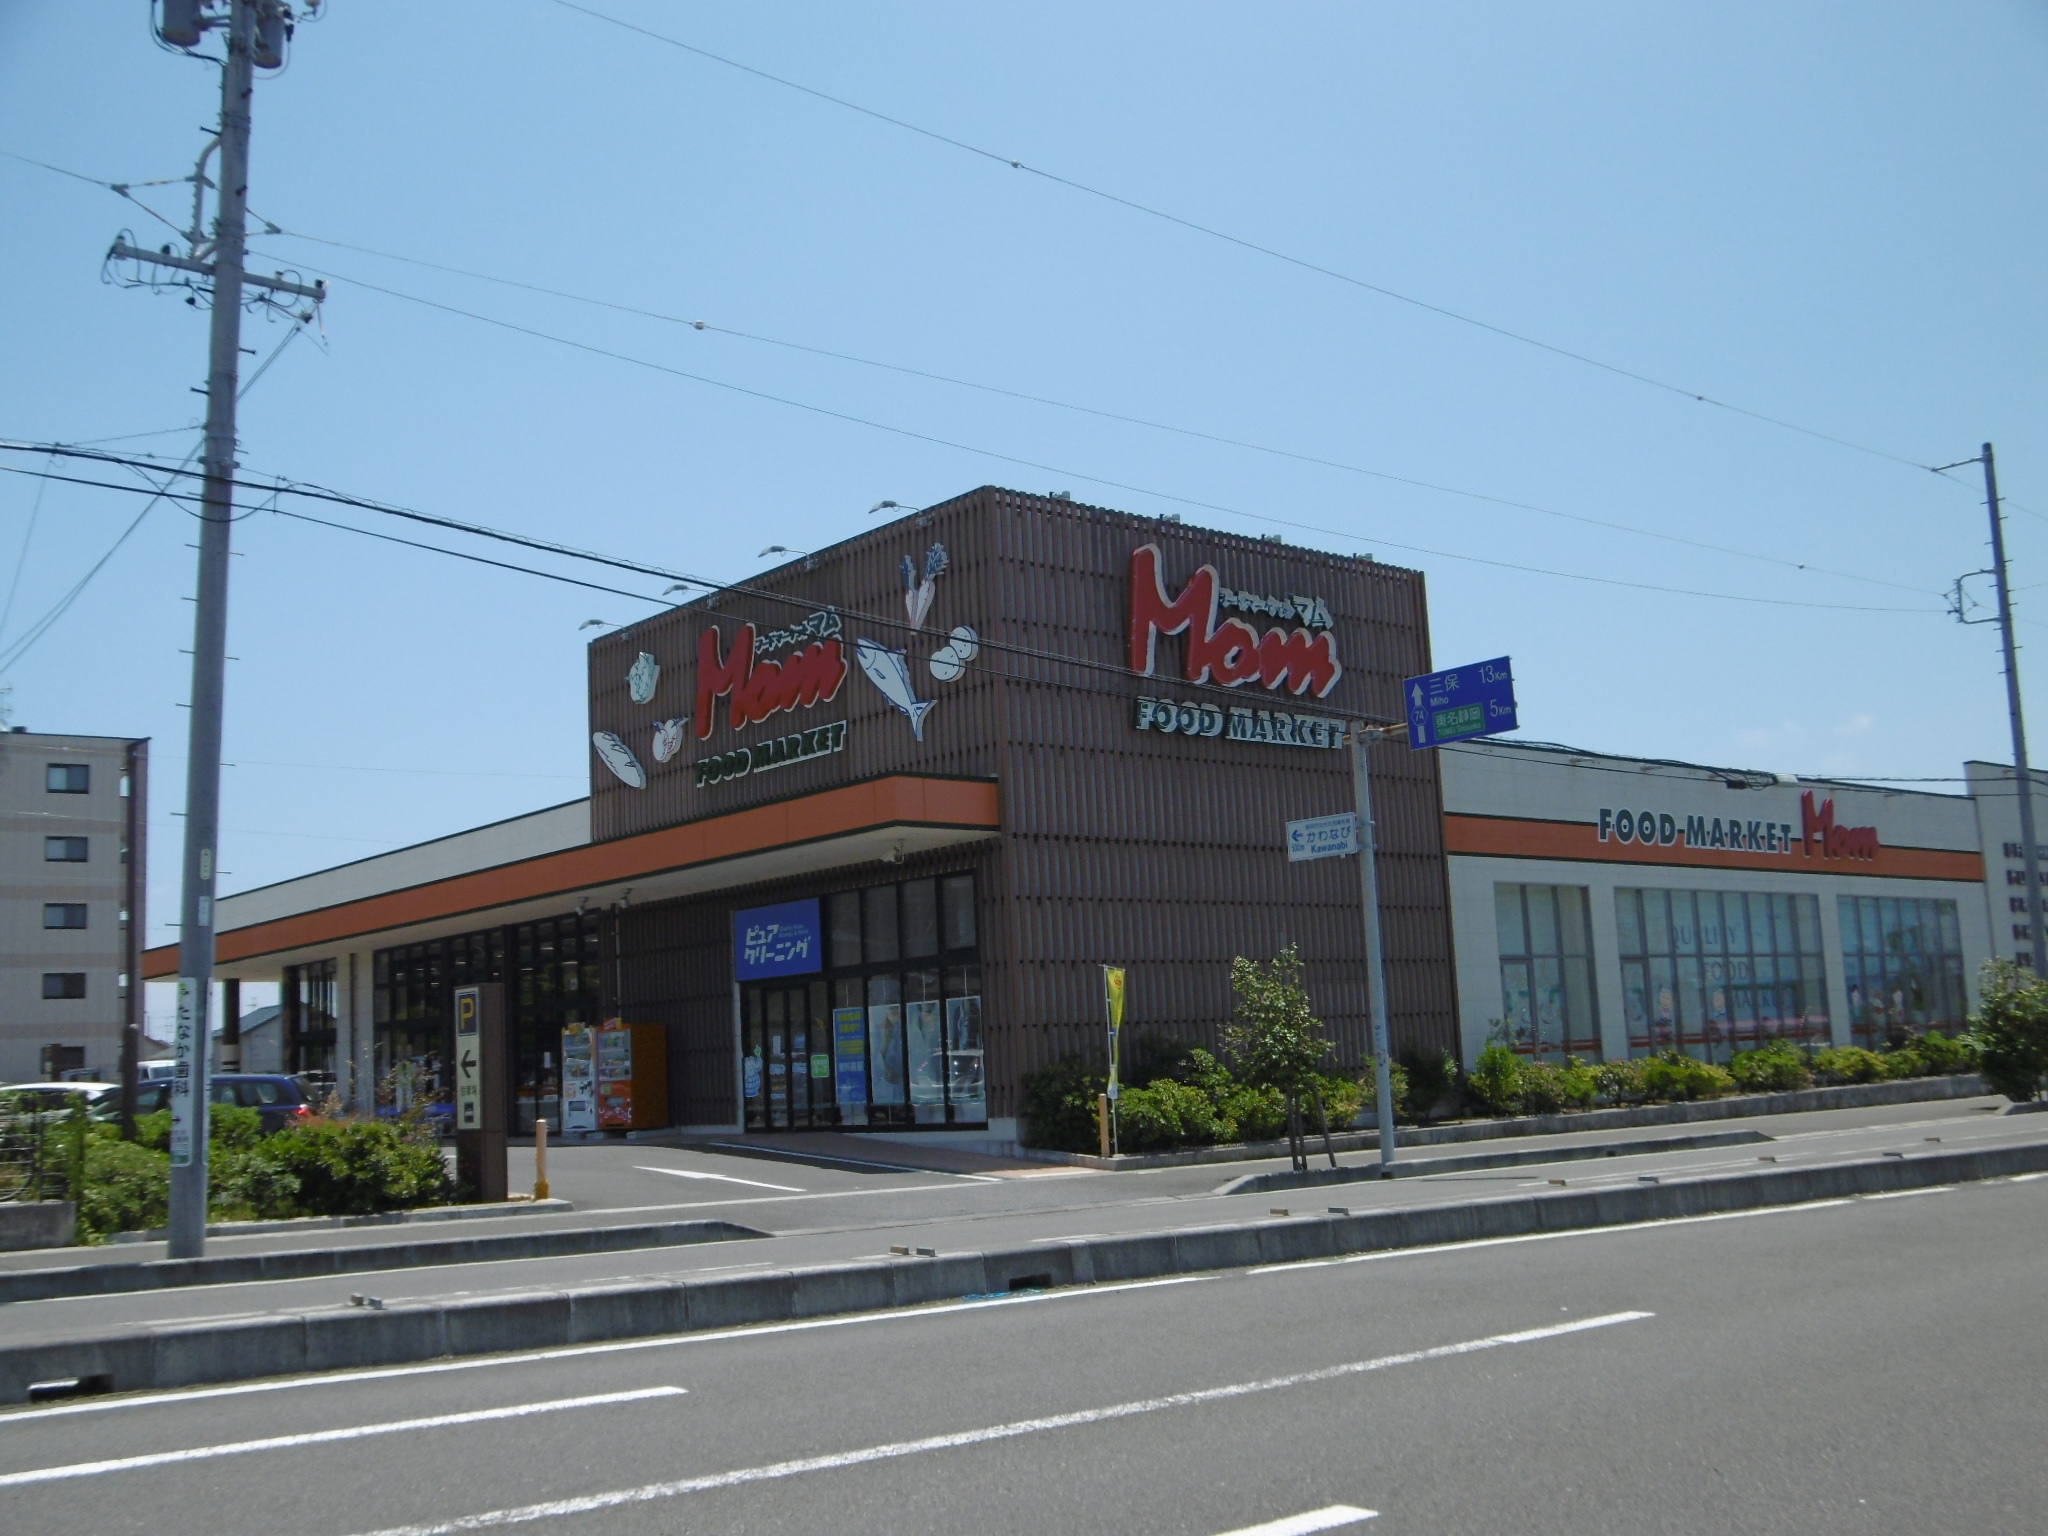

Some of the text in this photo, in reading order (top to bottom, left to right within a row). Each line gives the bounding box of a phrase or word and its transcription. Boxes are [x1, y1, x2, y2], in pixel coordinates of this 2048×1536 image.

[1131, 543, 1343, 699] Mom
[696, 623, 848, 741] Mom
[1429, 673, 1460, 695] 三保
[1414, 709, 1425, 722] 74
[1430, 696, 1449, 707] Miho
[1435, 706, 1481, 728] 東名静岡
[1136, 695, 1346, 749] FOOD MARKET
[696, 720, 848, 788] FOOD MARKET
[1306, 825, 1351, 844] かわなび
[1598, 807, 1793, 855] FOOD MARKET
[1800, 789, 1880, 862] Mom
[1291, 840, 1348, 854] 500m Kawanabi
[744, 935, 812, 965] クリーニング
[746, 924, 780, 946] ピュア
[460, 997, 475, 1030] P
[174, 1006, 191, 1098] たなか歯科
